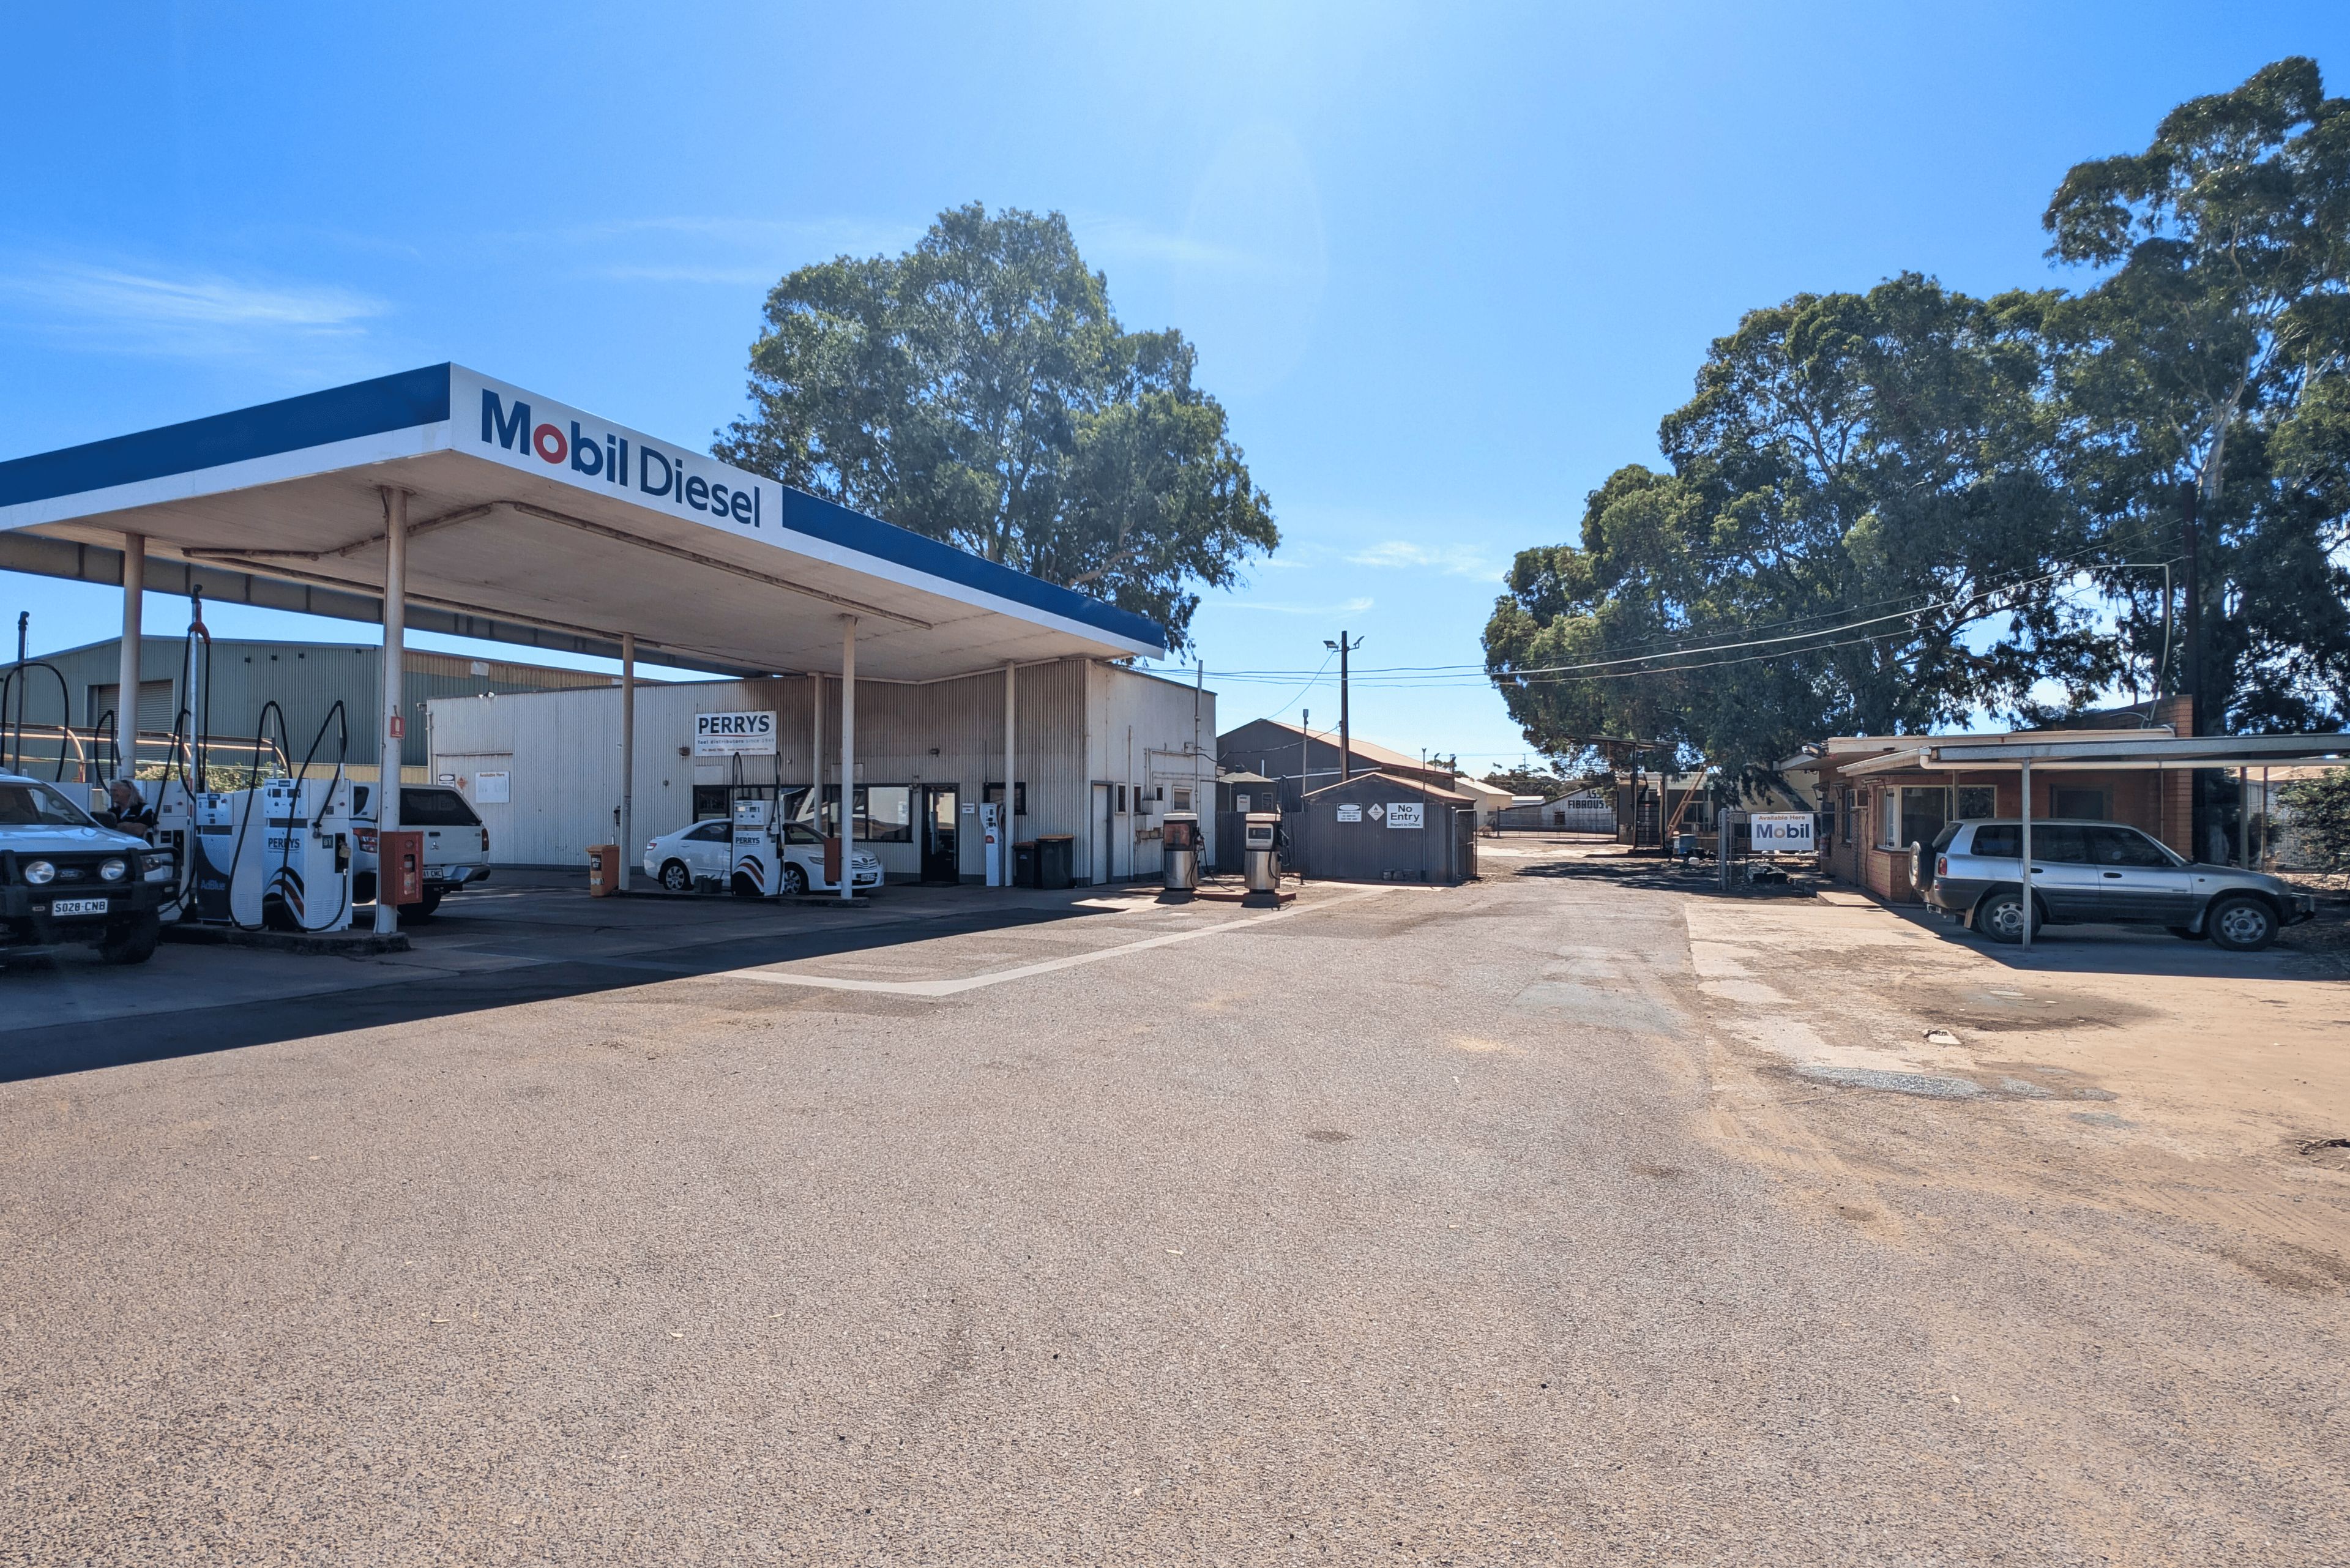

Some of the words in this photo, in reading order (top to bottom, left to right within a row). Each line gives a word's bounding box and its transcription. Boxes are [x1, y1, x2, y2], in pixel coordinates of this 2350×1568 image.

[481, 388, 629, 487] Mobil
[640, 445, 760, 528] Diesel
[698, 714, 770, 734] PERRYS
[1390, 813, 1420, 822] Entry
[1756, 823, 1810, 838] Mobil
[200, 879, 226, 890] AdBlue
